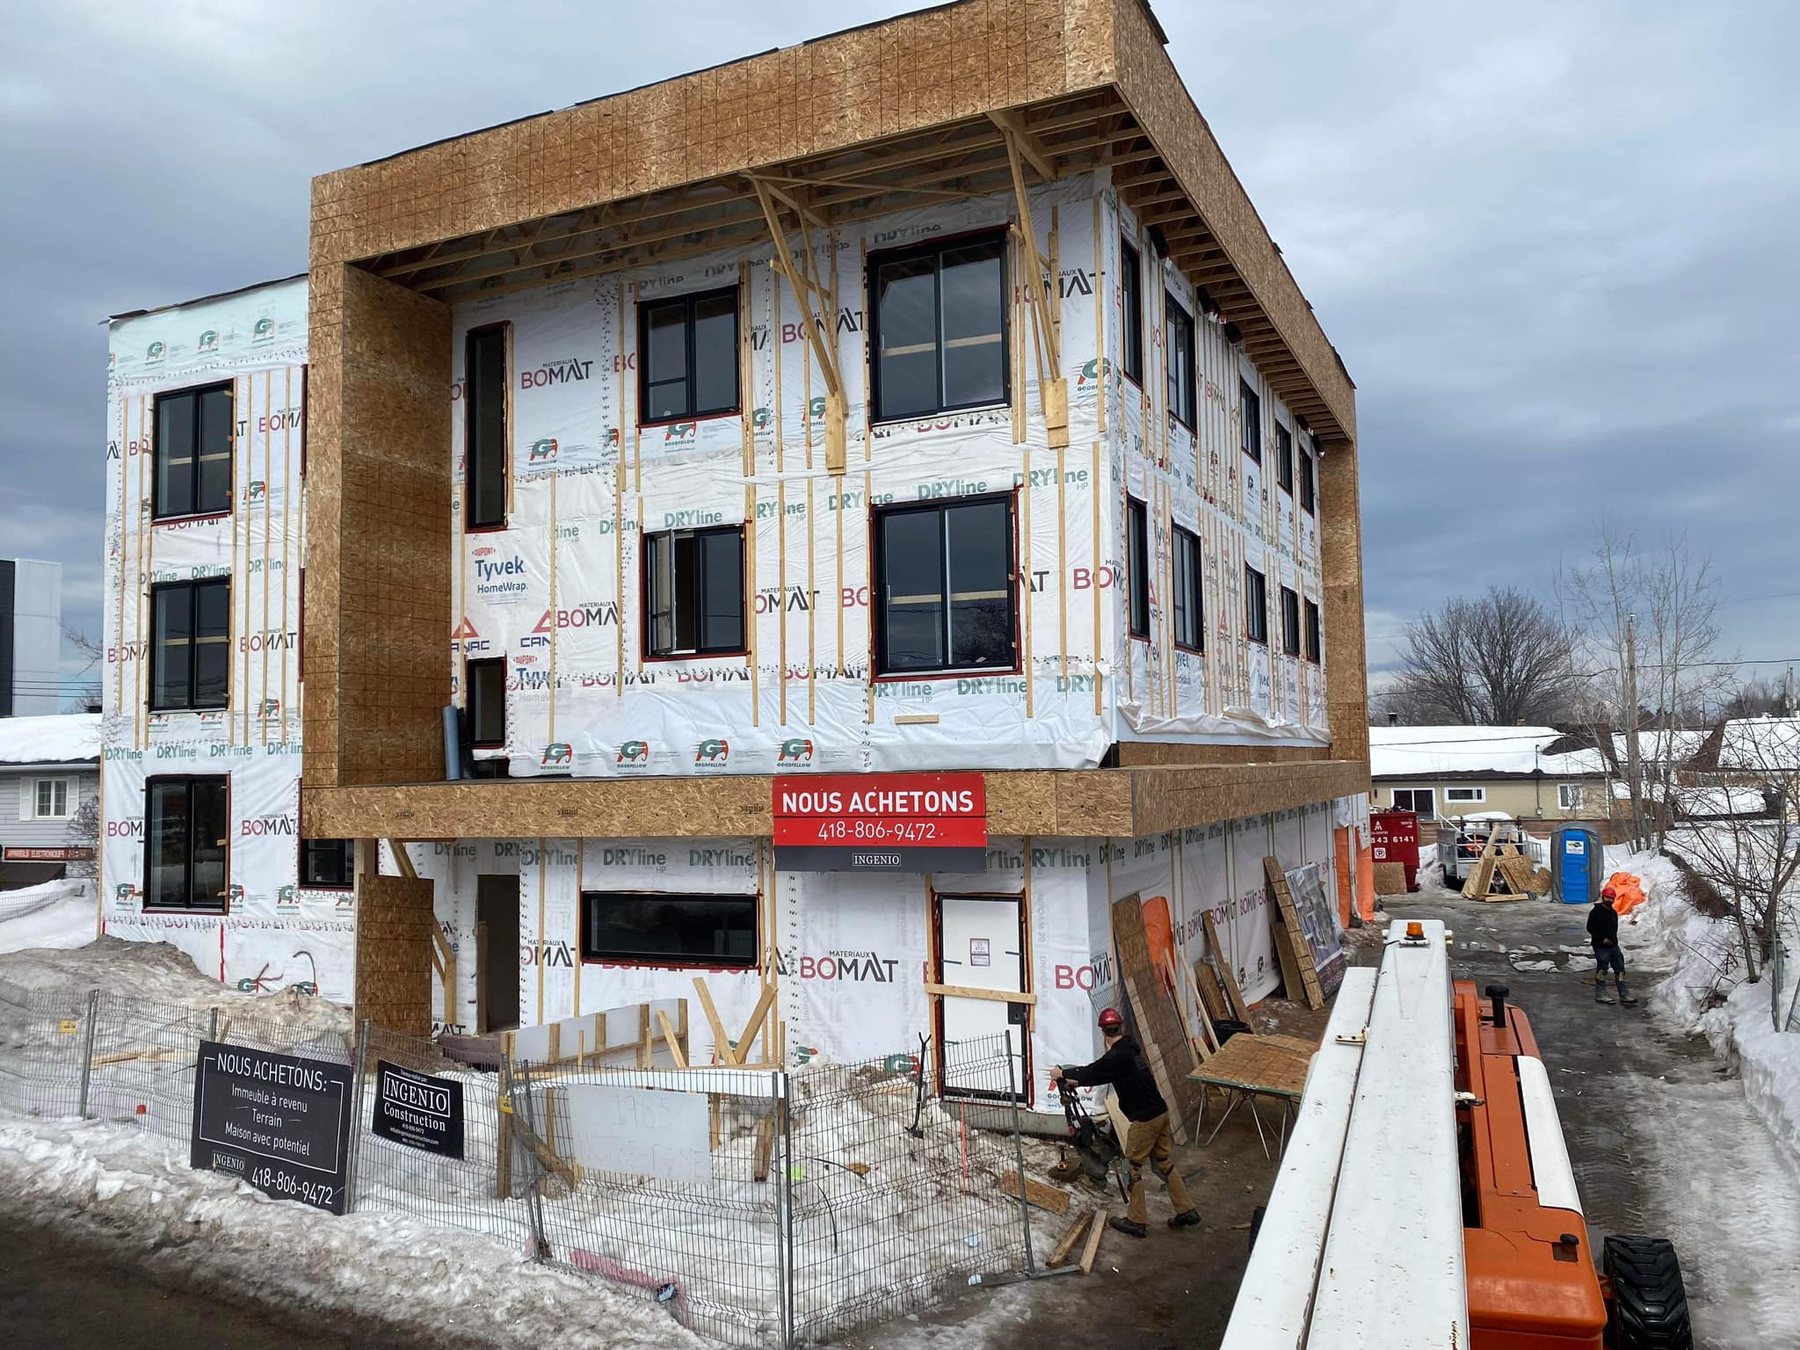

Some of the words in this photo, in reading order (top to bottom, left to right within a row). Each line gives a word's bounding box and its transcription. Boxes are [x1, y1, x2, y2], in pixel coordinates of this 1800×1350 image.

[521, 358, 594, 389] BOMAT
[917, 479, 987, 500] DRYline
[664, 510, 723, 528] DRYline
[475, 556, 525, 581] Tyvek
[477, 582, 526, 594] HomeWrap
[105, 748, 143, 761] DRYline
[157, 745, 197, 759] DRYline
[782, 792, 842, 814] NOUS
[849, 790, 973, 814] ACHETONS
[818, 821, 936, 840] 418-806-9472
[603, 849, 667, 867] DRYline
[689, 849, 755, 867] DRYline
[853, 854, 900, 866] INGENIO
[829, 950, 870, 958] MATERIAUX
[801, 951, 899, 983] BOMAT
[217, 1052, 251, 1076] NOUS
[253, 1060, 327, 1092] ACHETONS:
[232, 1083, 269, 1104] Immeuble
[271, 1092, 277, 1106] à
[279, 1097, 308, 1112] revenu
[385, 1077, 447, 1112] INGENIO
[252, 1108, 282, 1127] Terrain
[384, 1102, 446, 1131] Construction
[225, 1121, 251, 1140] Maison
[253, 1133, 271, 1146] avec
[273, 1137, 310, 1156] potentiel
[213, 1153, 245, 1171] INGENIO
[252, 1166, 333, 1205] 418-806-9472
